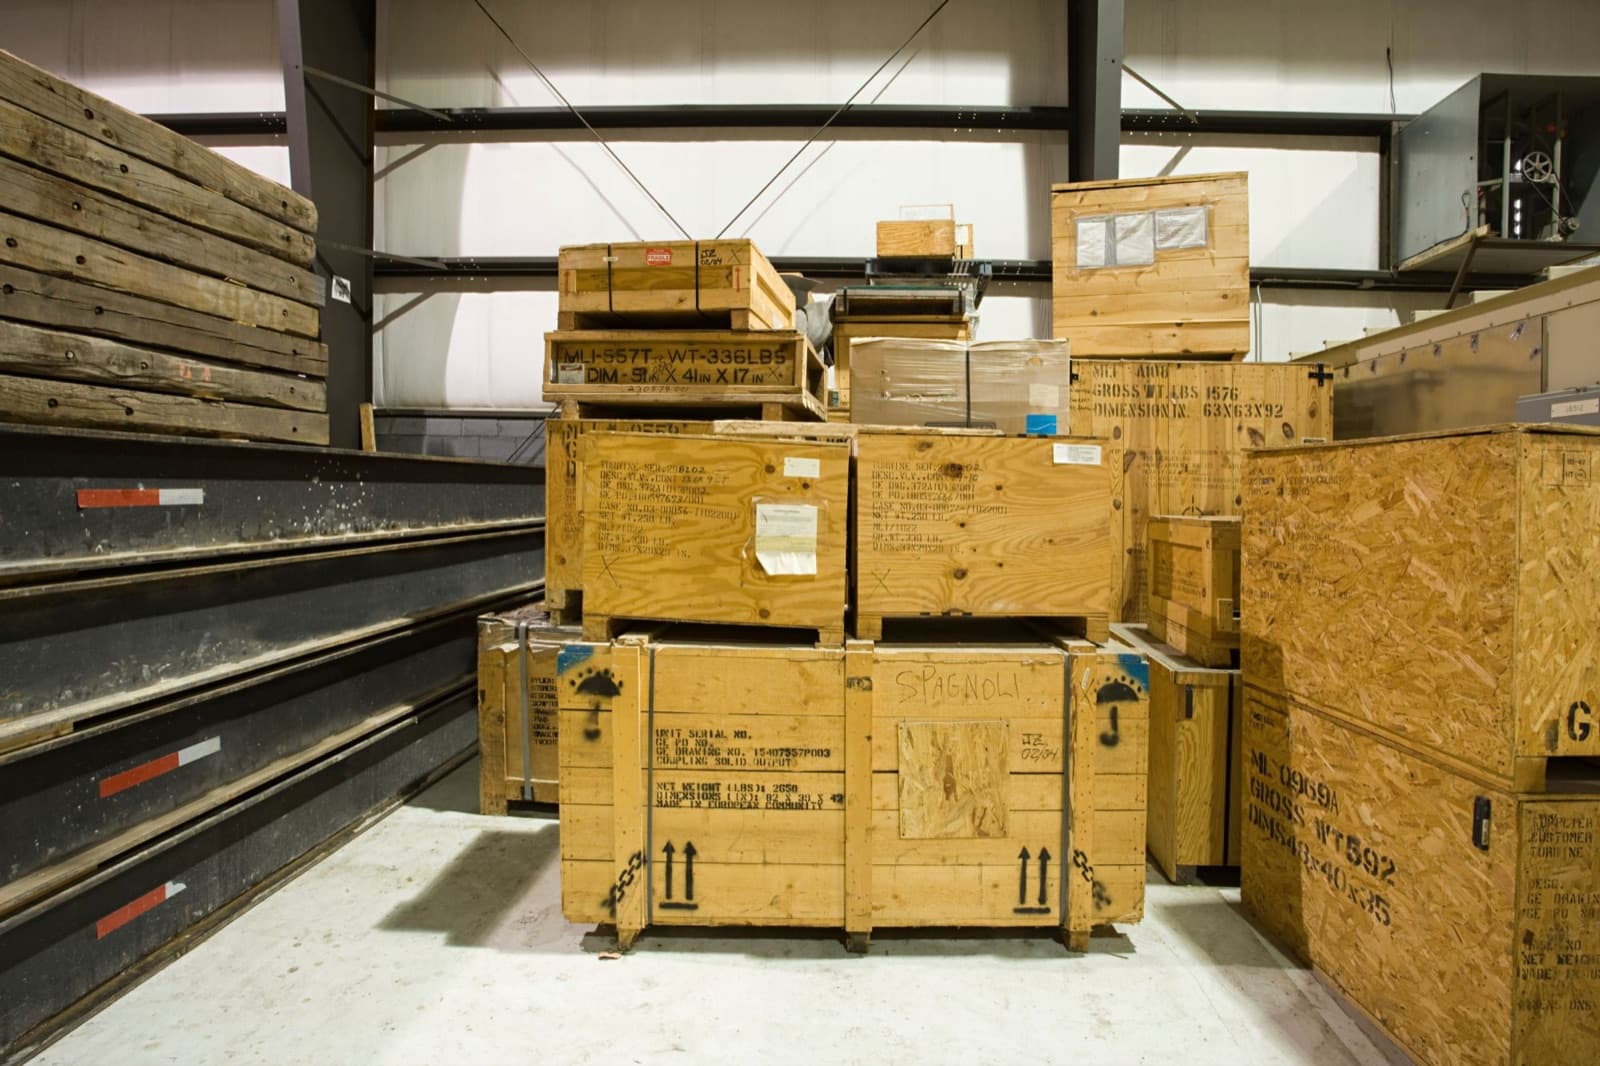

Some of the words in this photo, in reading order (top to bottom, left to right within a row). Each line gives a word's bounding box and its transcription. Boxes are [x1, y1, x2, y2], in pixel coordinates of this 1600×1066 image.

[667, 349, 786, 365] WT-336LBS
[587, 367, 618, 384] DIM
[682, 367, 698, 384] 41
[716, 368, 728, 384] X
[733, 366, 748, 384] 17
[1093, 383, 1140, 398] GROSS
[1206, 386, 1239, 401] 1576
[895, 665, 1021, 703] SPAGNOLI
[1567, 701, 1591, 741] G
[656, 729, 683, 739] UNIT
[688, 730, 727, 740] SERIAL
[733, 731, 753, 740] NO.
[675, 748, 721, 756] DRAWING
[726, 749, 746, 757] NO.
[714, 758, 747, 767] SOLID
[655, 782, 677, 792] NET
[681, 782, 722, 792] WEIGHT
